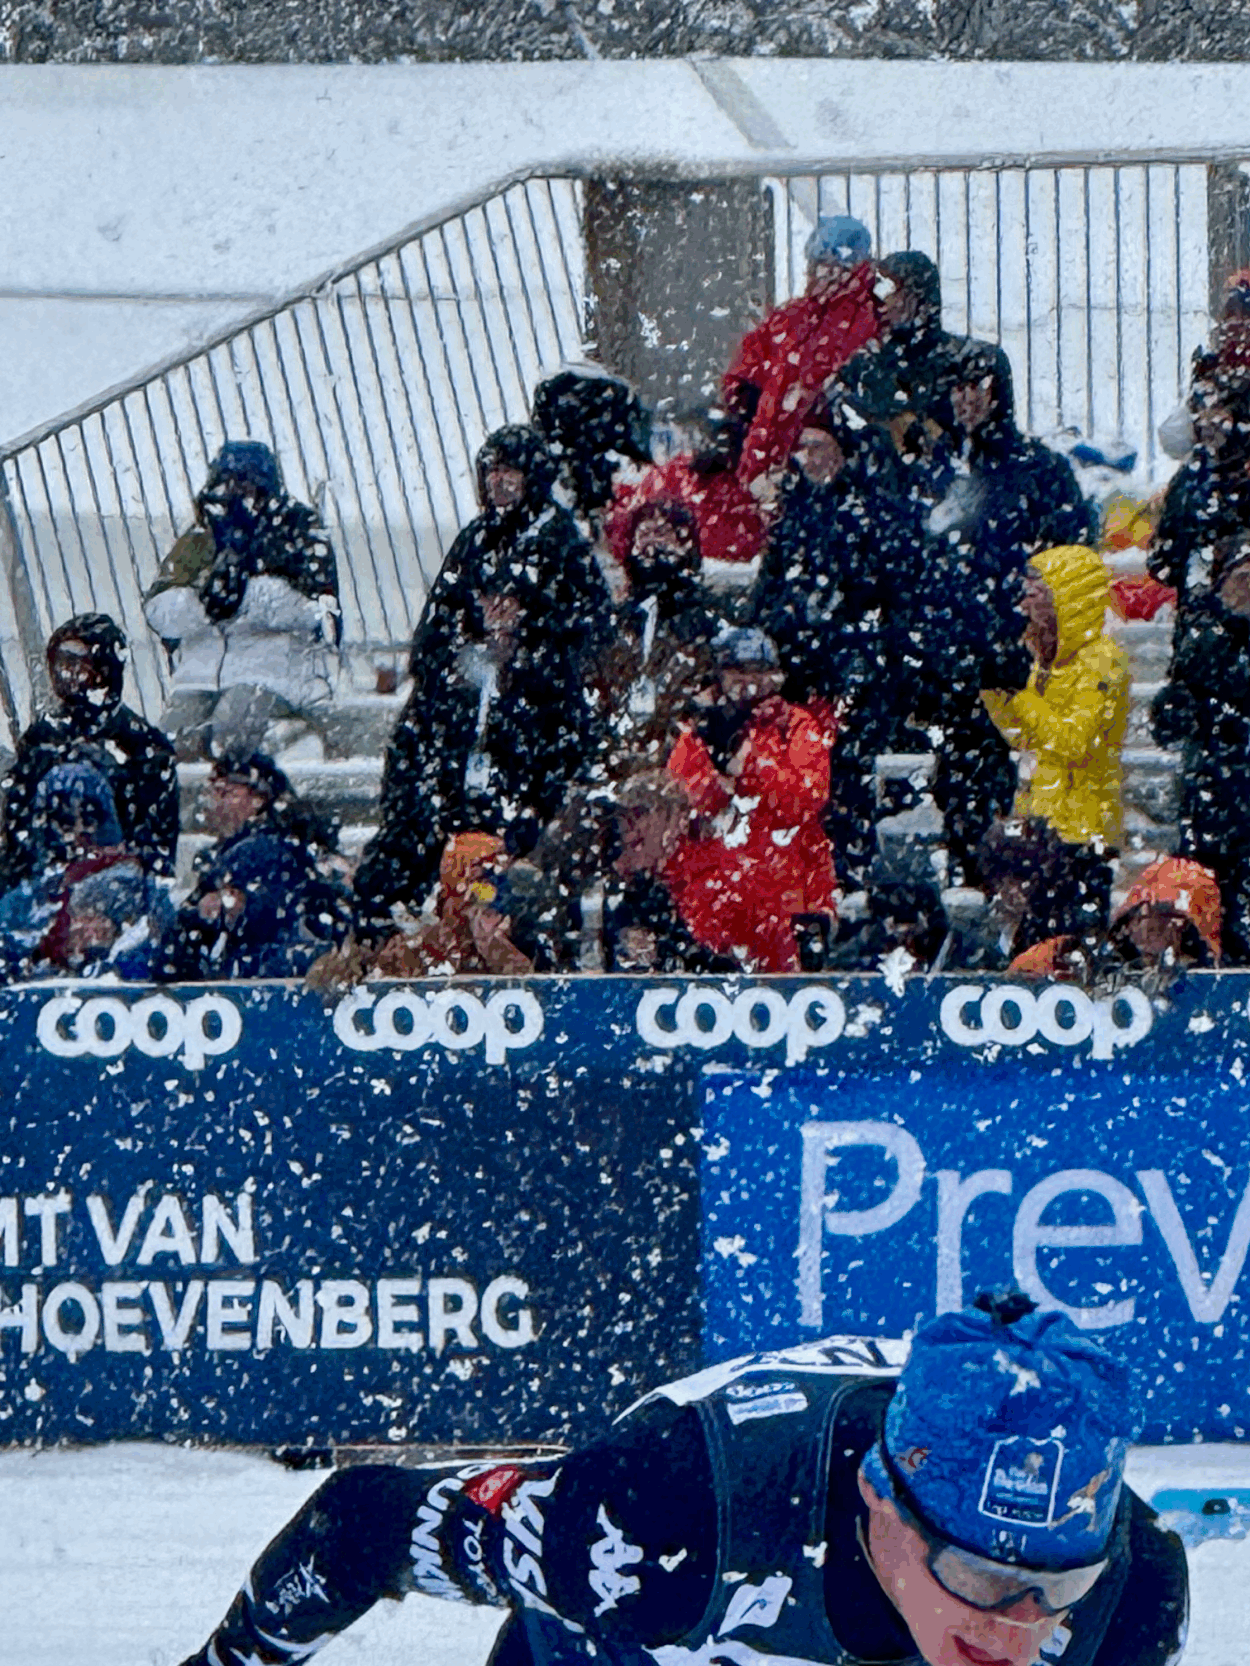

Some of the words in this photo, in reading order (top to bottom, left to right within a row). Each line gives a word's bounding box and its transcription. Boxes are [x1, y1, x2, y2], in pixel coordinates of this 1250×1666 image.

[38, 992, 242, 1070] coop
[333, 989, 544, 1065] coop
[636, 986, 848, 1065] coop
[941, 984, 1153, 1060] coop
[86, 1192, 256, 1266] VAN
